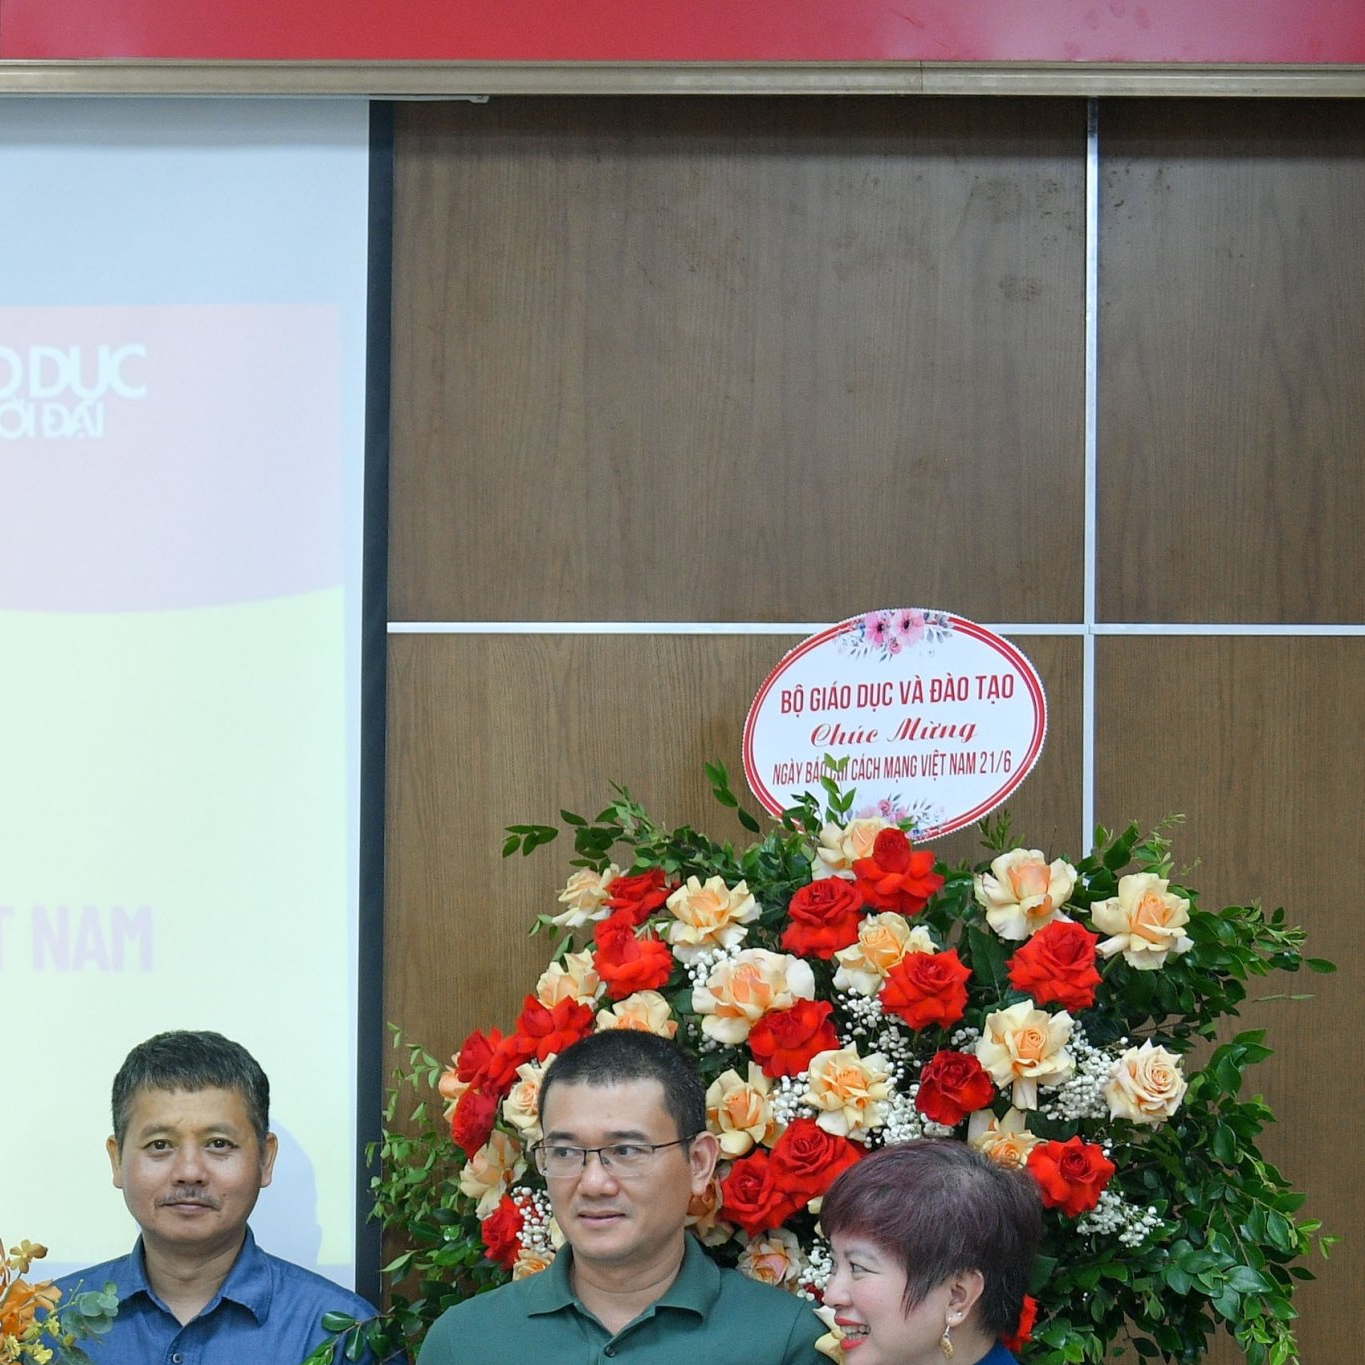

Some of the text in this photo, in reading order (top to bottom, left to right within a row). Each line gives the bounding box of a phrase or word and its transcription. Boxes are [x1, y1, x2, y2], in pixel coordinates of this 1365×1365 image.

[781, 673, 1014, 717] BỘ GIÁO DỤC VÀ ĐÀO TẠO
[810, 717, 978, 747] Chúc Mừng
[772, 757, 803, 786] NGÀY
[851, 753, 881, 781] CÁCH
[884, 756, 917, 783] MẠNG
[921, 750, 948, 781] VIỆT
[949, 754, 977, 776] NAM
[980, 749, 1012, 775] 21/6
[31, 904, 154, 973] NAM
